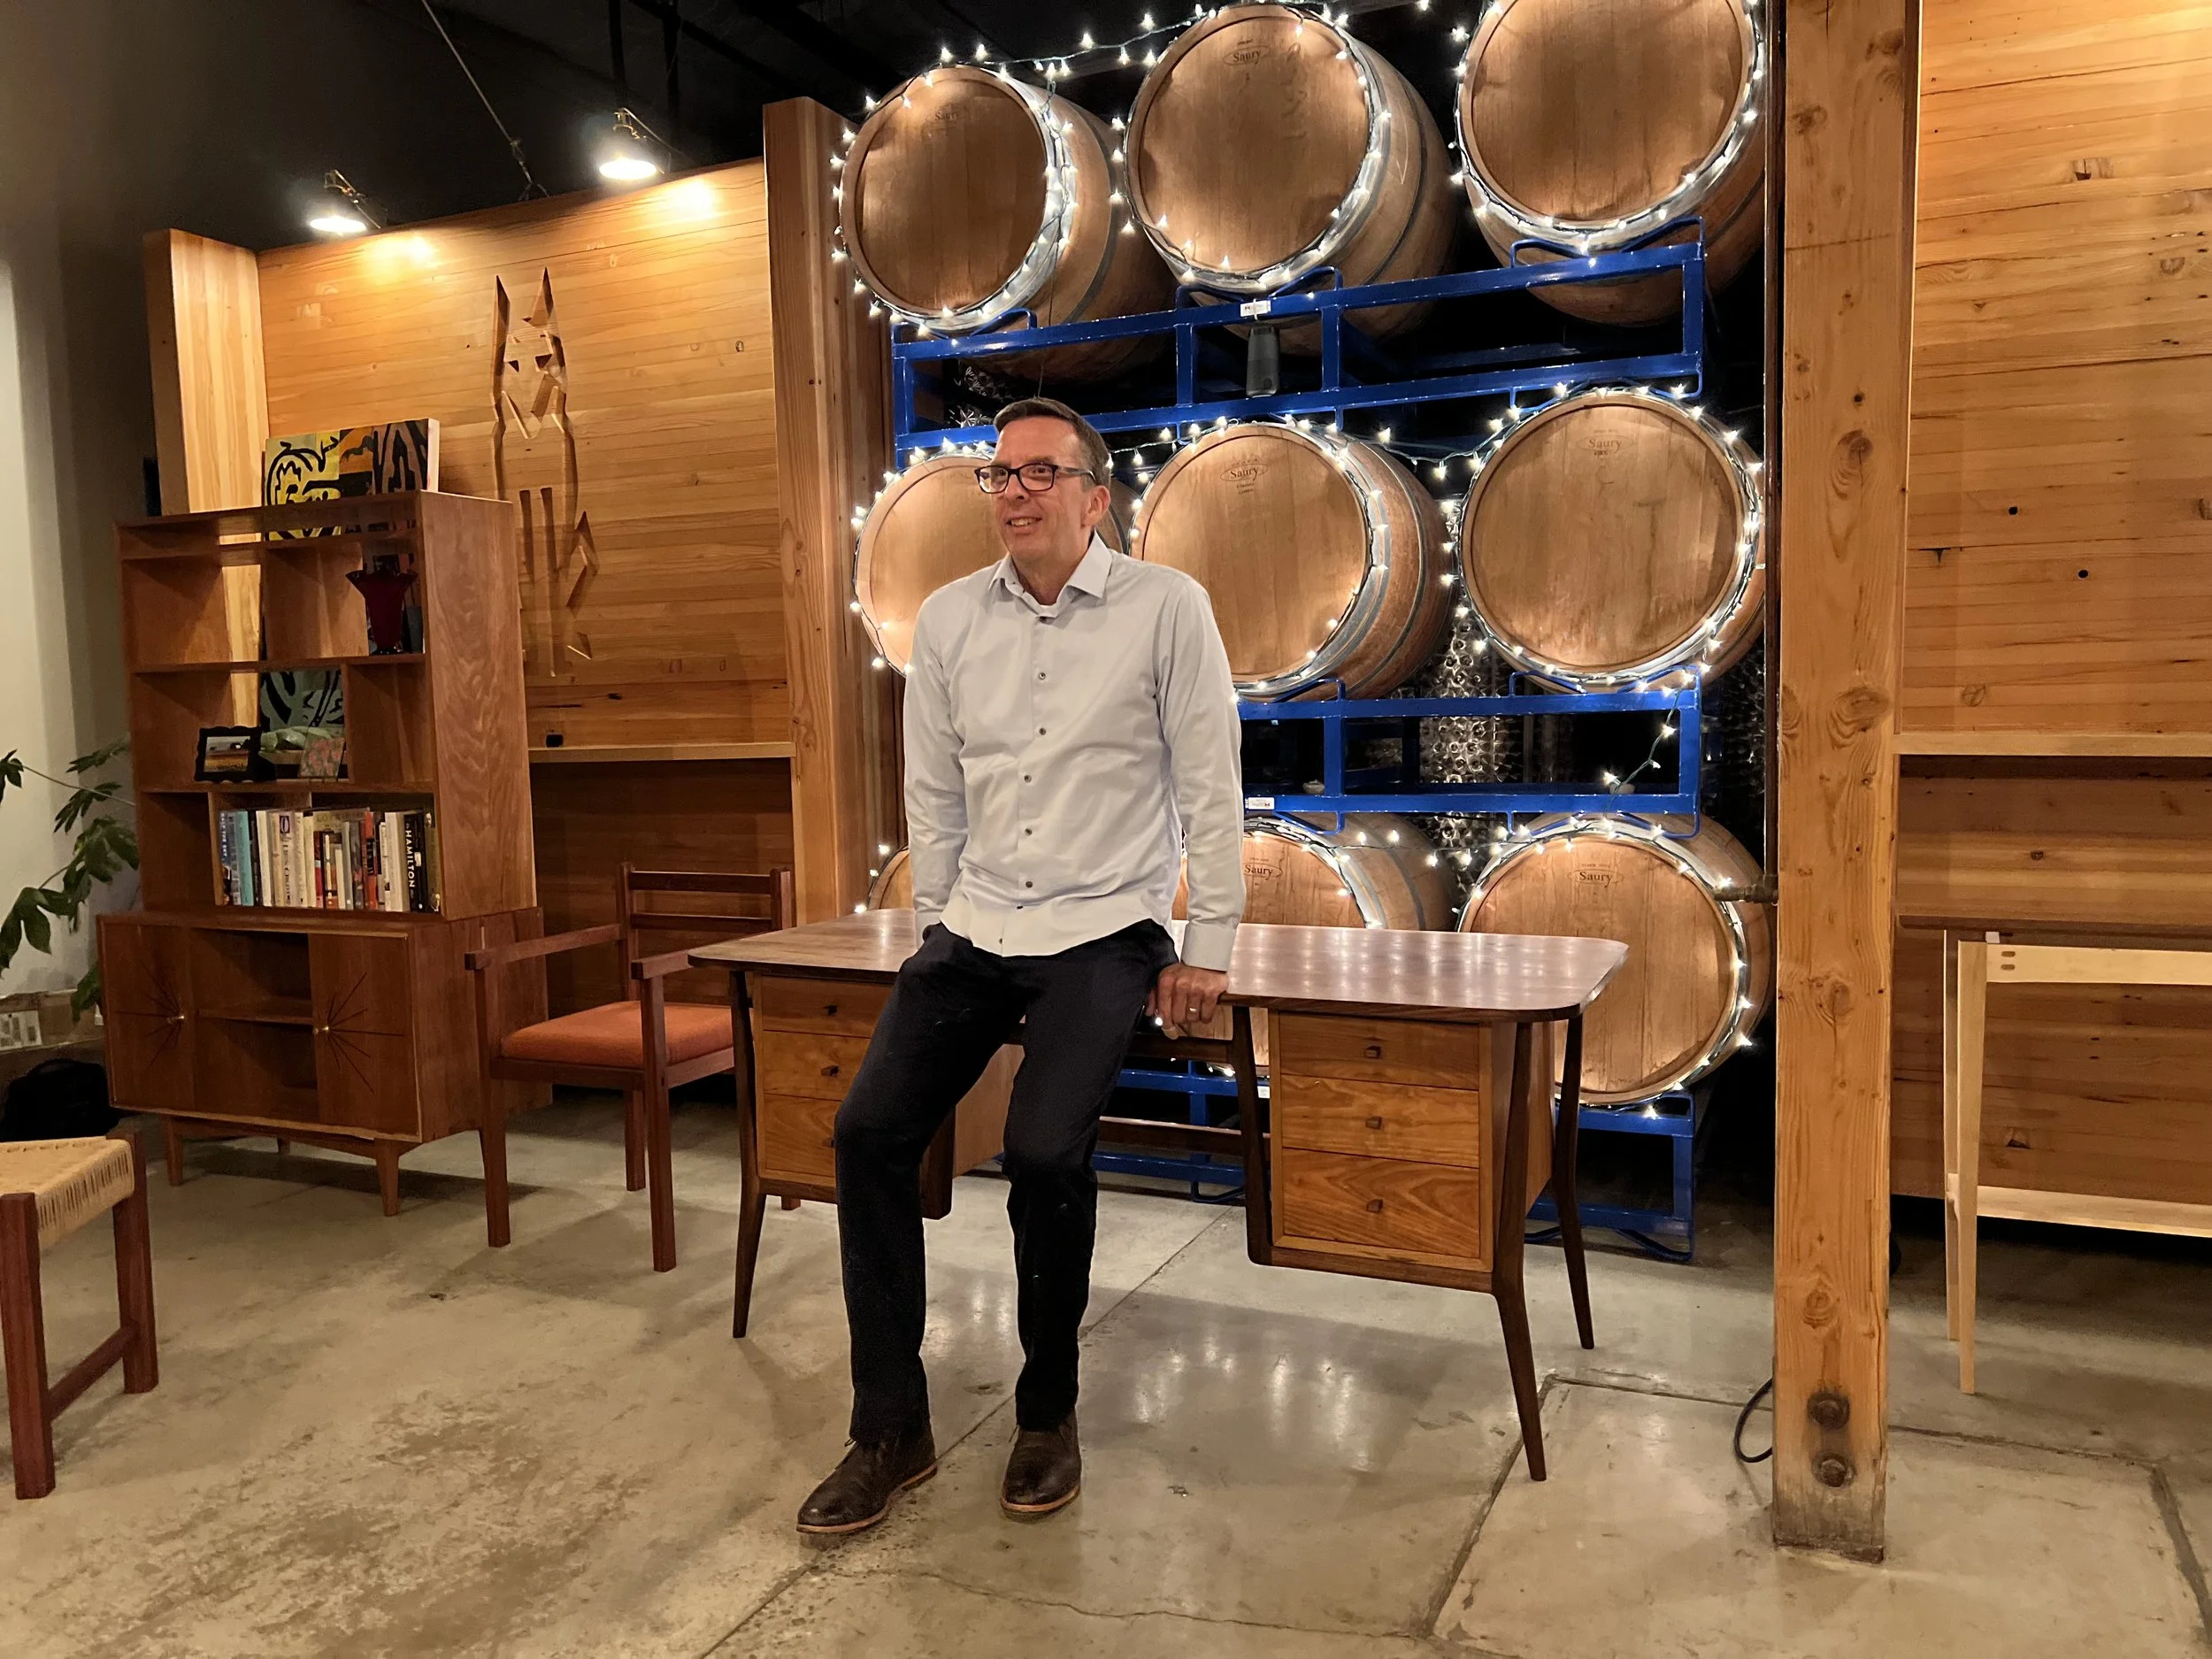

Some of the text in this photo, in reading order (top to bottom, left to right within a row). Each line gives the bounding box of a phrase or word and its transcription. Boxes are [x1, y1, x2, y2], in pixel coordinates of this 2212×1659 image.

[1233, 50, 1261, 65] Saury
[1588, 438, 1623, 453] Saury
[1230, 467, 1259, 481] Saury
[405, 830, 416, 887] HAMILTON
[1244, 864, 1273, 880] Saury
[1578, 872, 1613, 888] Saury
